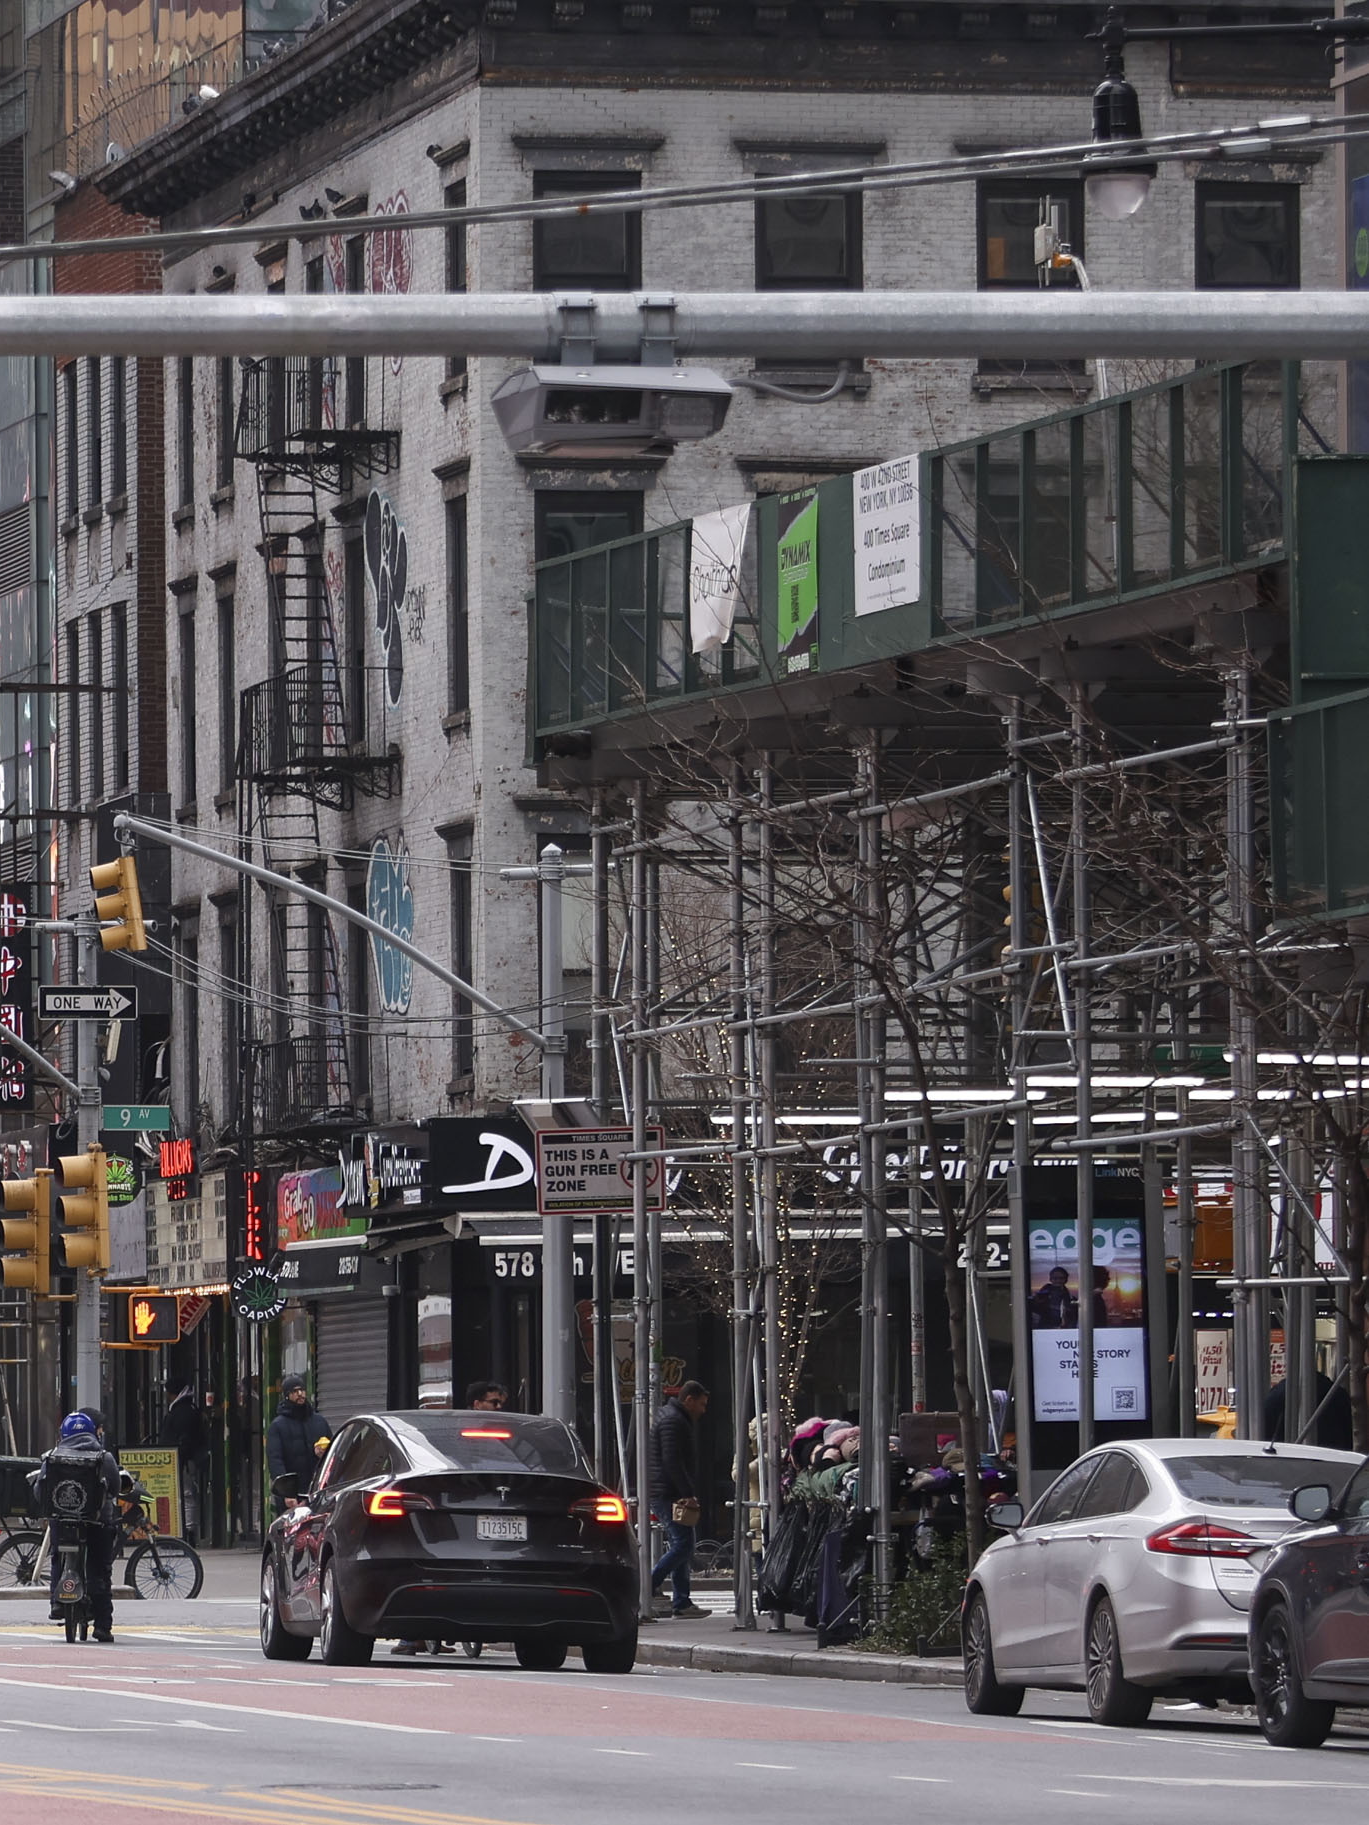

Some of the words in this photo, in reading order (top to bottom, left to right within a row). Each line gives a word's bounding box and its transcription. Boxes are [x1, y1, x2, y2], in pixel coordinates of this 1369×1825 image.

[860, 472, 870, 491] 400
[871, 470, 877, 488] W
[878, 466, 891, 486] 42ND
[893, 460, 910, 483] STREET
[859, 496, 872, 514] NEW
[873, 489, 888, 510] YORK,
[889, 487, 897, 506] NY
[897, 482, 913, 504] 10036
[863, 528, 874, 549] 400
[874, 524, 890, 547] Times
[890, 522, 910, 545] Square
[867, 555, 906, 582] Condominium
[53, 996, 81, 1009] ONE
[93, 996, 122, 1009] WAY
[120, 1109, 131, 1127] 9
[138, 1109, 150, 1119] AV
[571, 1134, 596, 1142] TIMES
[597, 1133, 629, 1142] SQUARE
[544, 1149, 578, 1162] THIS
[582, 1149, 596, 1161] IS
[599, 1149, 610, 1160] A
[545, 1164, 576, 1177] GUN
[581, 1163, 617, 1176] FREE
[1095, 1167, 1139, 1177] LinkNYC
[546, 1179, 586, 1192] ZONE
[284, 1180, 302, 1220] Grab
[302, 1195, 314, 1232] GO
[1029, 1219, 1141, 1266] edge
[495, 1251, 534, 1278] 578
[239, 1297, 287, 1321] CAPITAL
[1055, 1340, 1080, 1350] YOU
[1097, 1349, 1131, 1359] STORY
[1059, 1360, 1098, 1369] STAS
[1071, 1370, 1099, 1378] HE
[121, 1453, 171, 1465] ZILLIONS
[482, 1521, 522, 1535] T123515C
